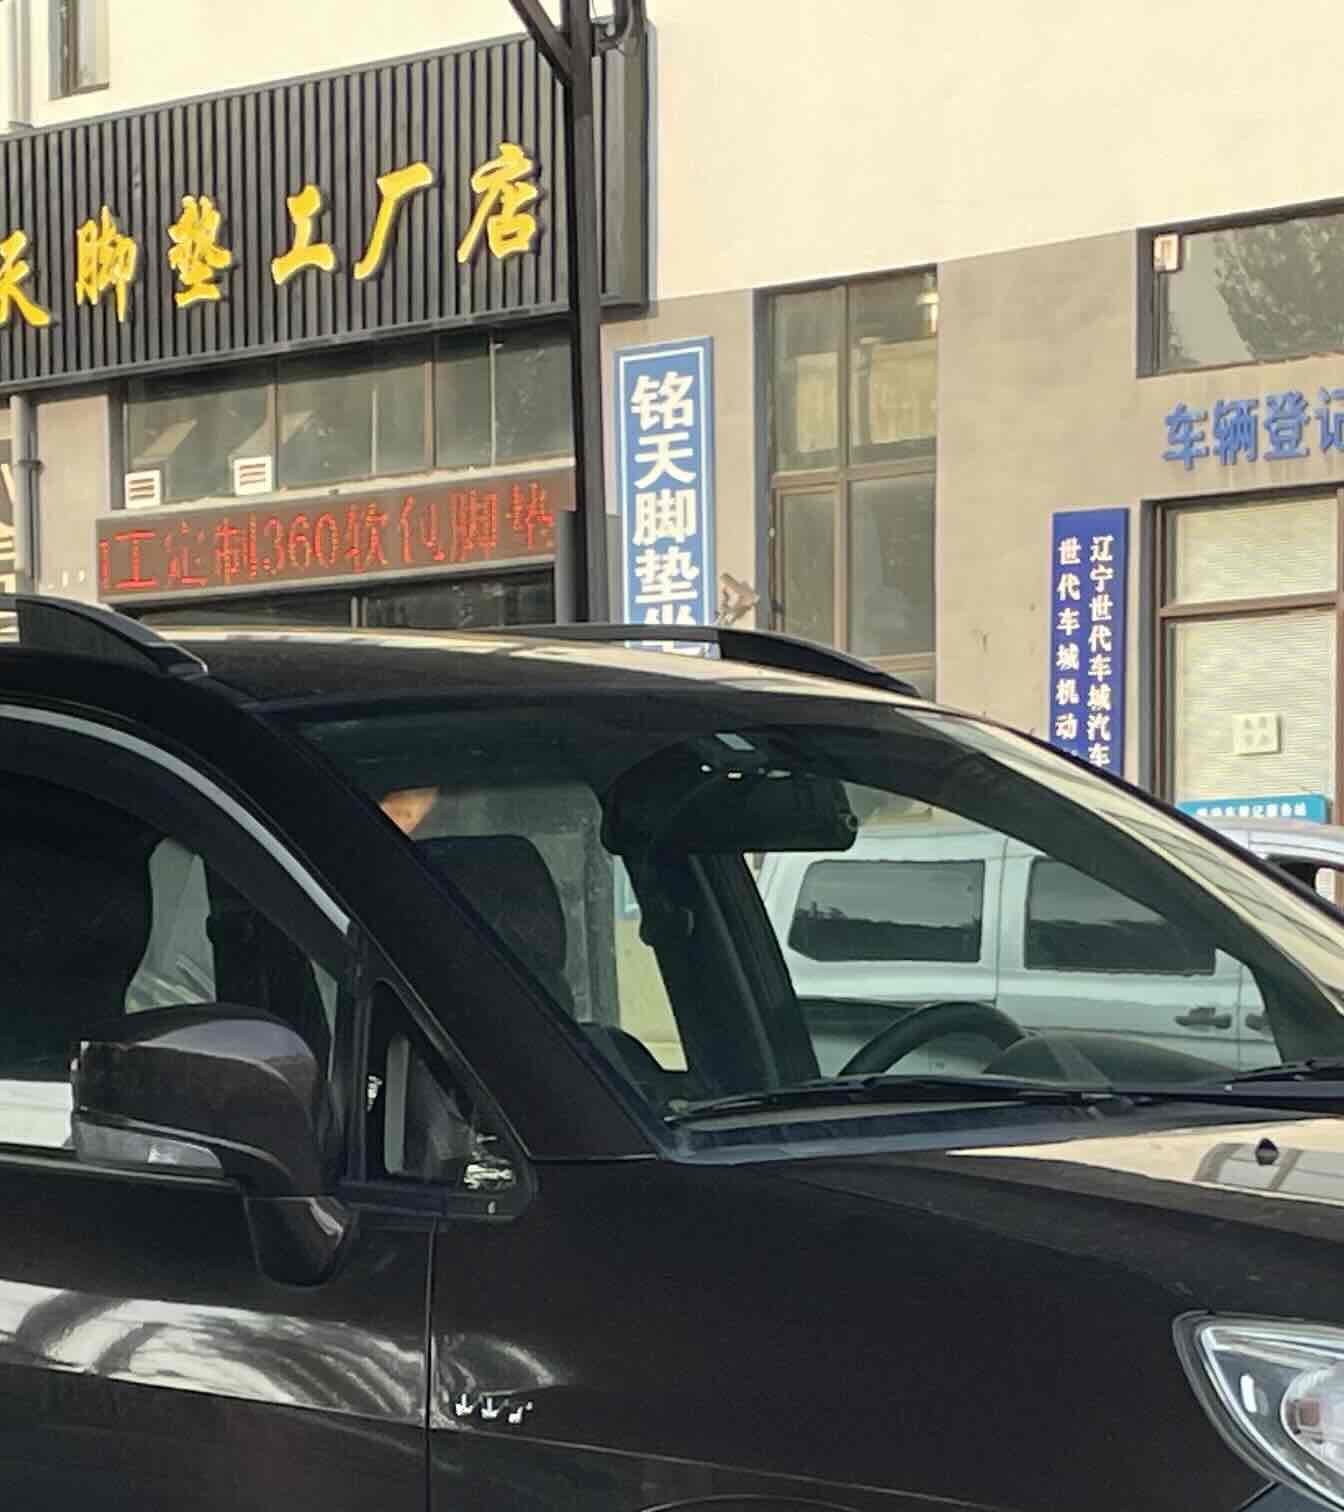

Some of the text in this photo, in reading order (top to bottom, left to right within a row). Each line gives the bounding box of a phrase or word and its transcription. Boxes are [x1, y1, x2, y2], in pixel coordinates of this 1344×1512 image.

[1055, 537, 1081, 756] 世代车城机动
